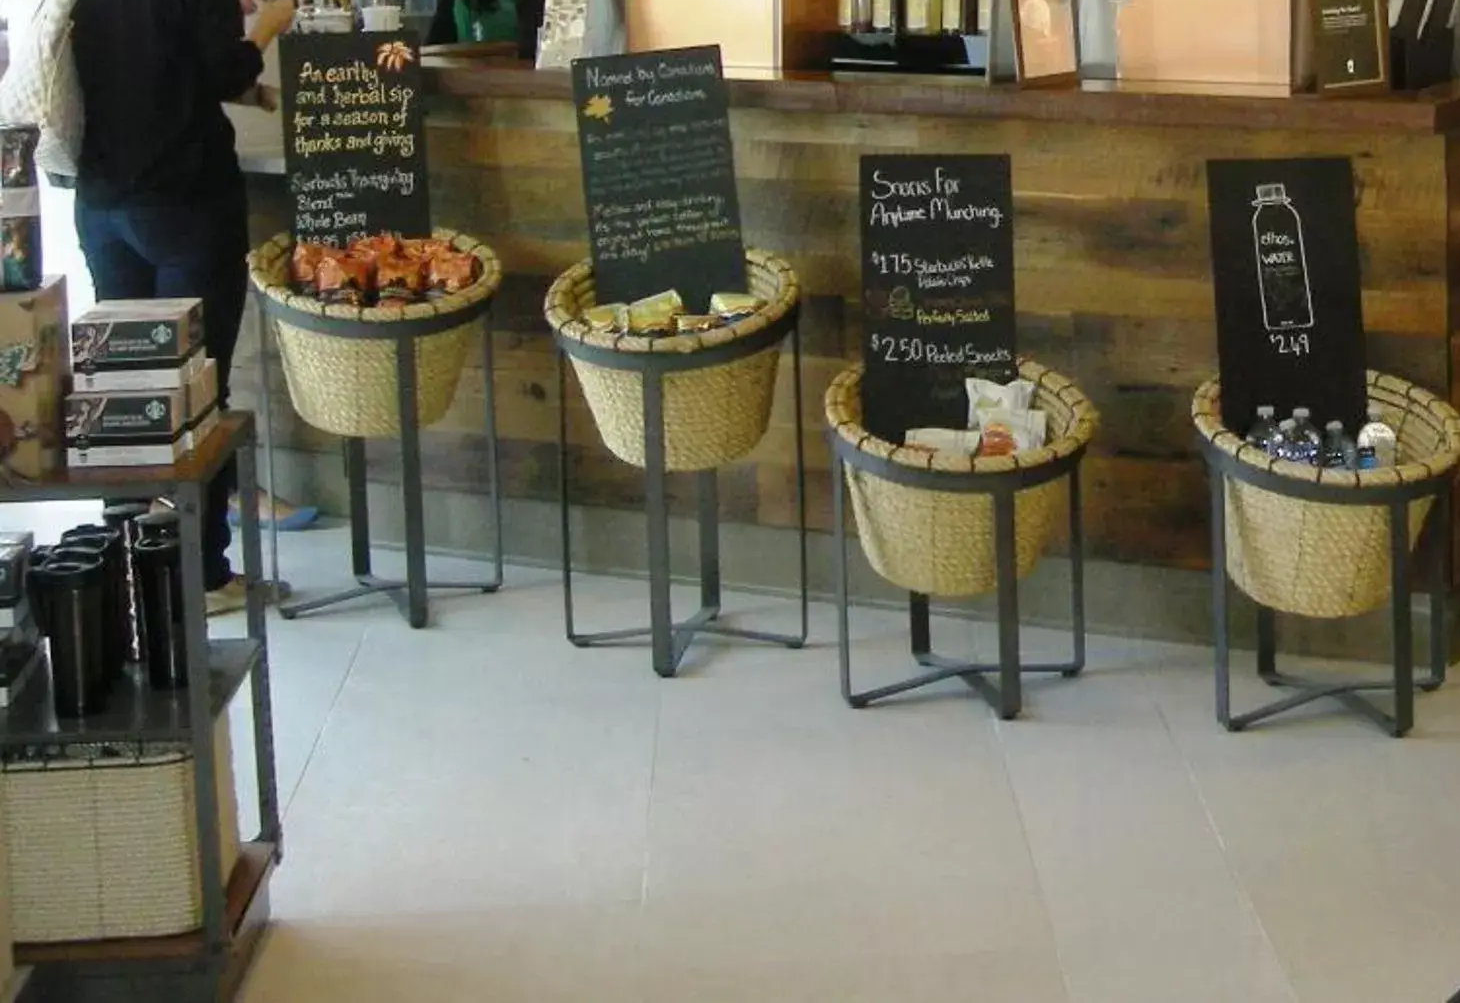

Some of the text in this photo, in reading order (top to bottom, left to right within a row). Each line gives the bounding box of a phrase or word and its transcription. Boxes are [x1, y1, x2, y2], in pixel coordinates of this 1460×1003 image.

[300, 59, 379, 90] An earthy
[296, 84, 415, 110] and herbal sip
[294, 110, 408, 133] for a season of
[295, 128, 415, 158] thanks and giving
[297, 193, 334, 211] Blend
